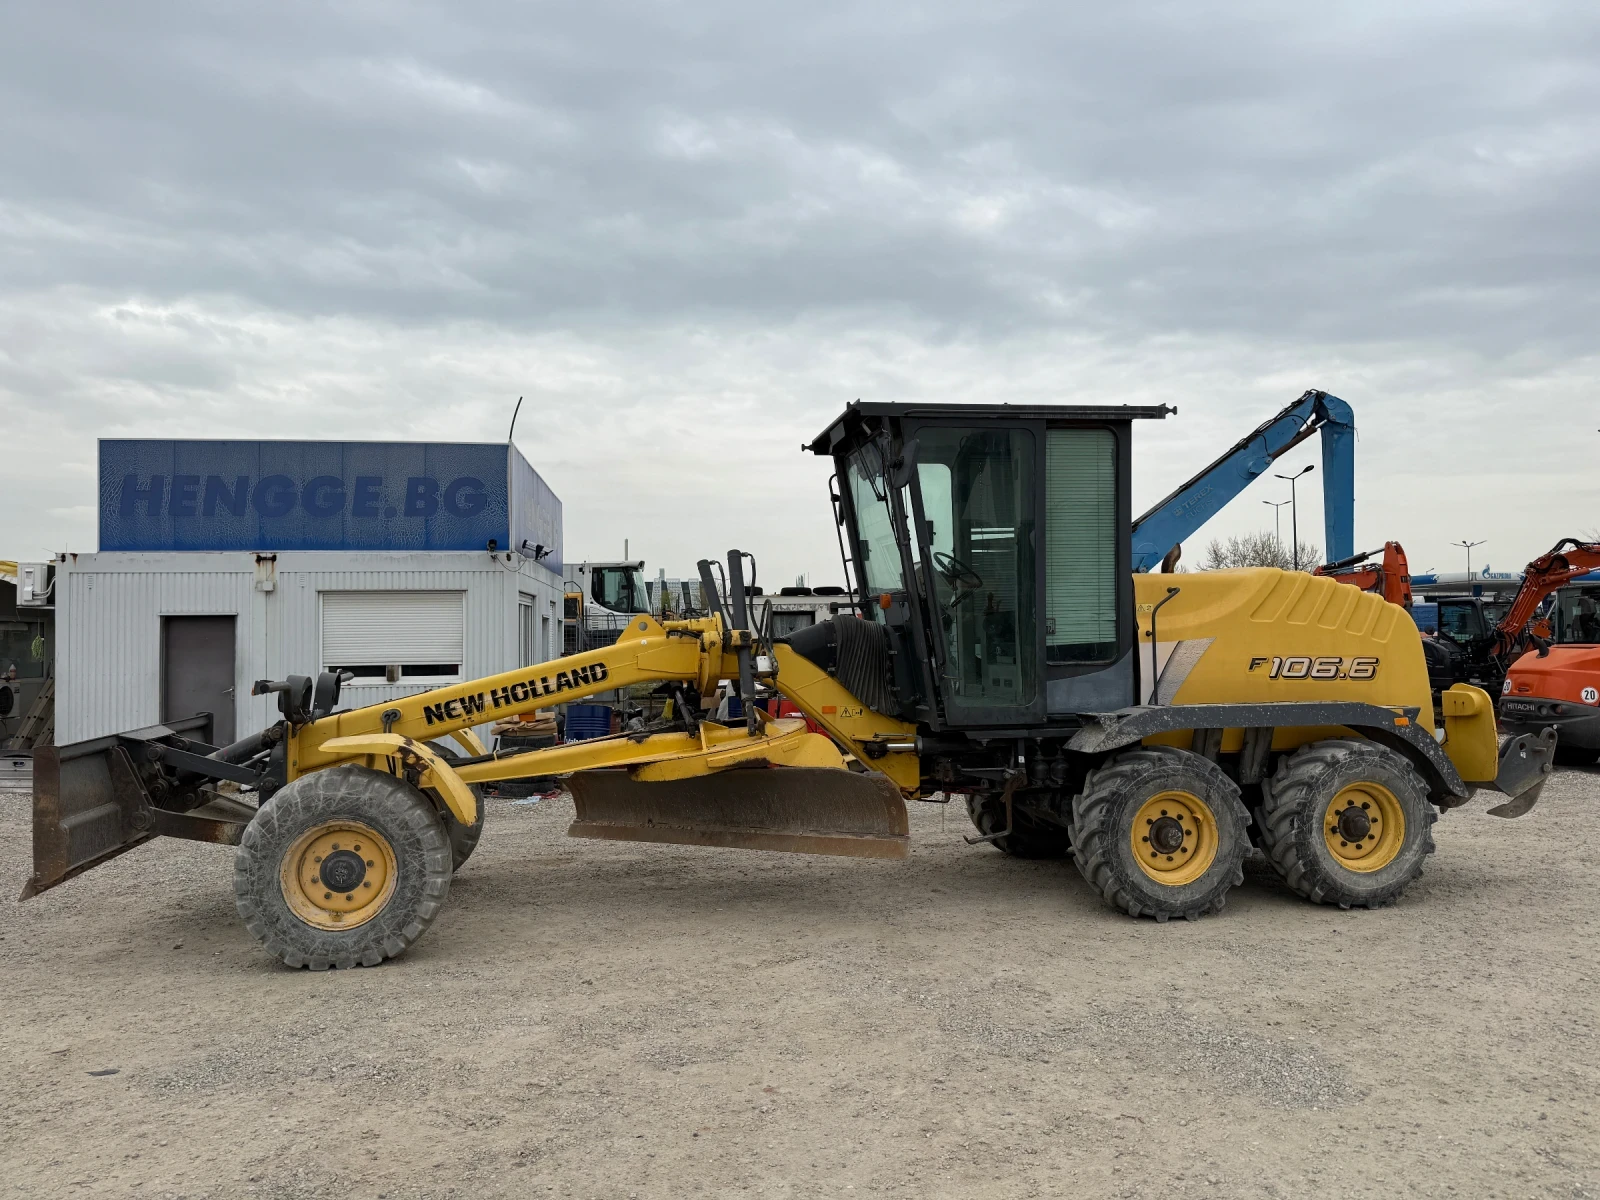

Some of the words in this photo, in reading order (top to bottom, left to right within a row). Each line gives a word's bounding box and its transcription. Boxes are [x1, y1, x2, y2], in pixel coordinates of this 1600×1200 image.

[119, 474, 487, 518] HENGGE.BG
[1182, 484, 1214, 509] TEREX
[1185, 498, 1214, 519] FUCHS
[423, 692, 485, 726] NEW
[490, 662, 609, 709] HOLLAND
[1584, 690, 1596, 700] 20
[1507, 702, 1535, 711] HITACHI
